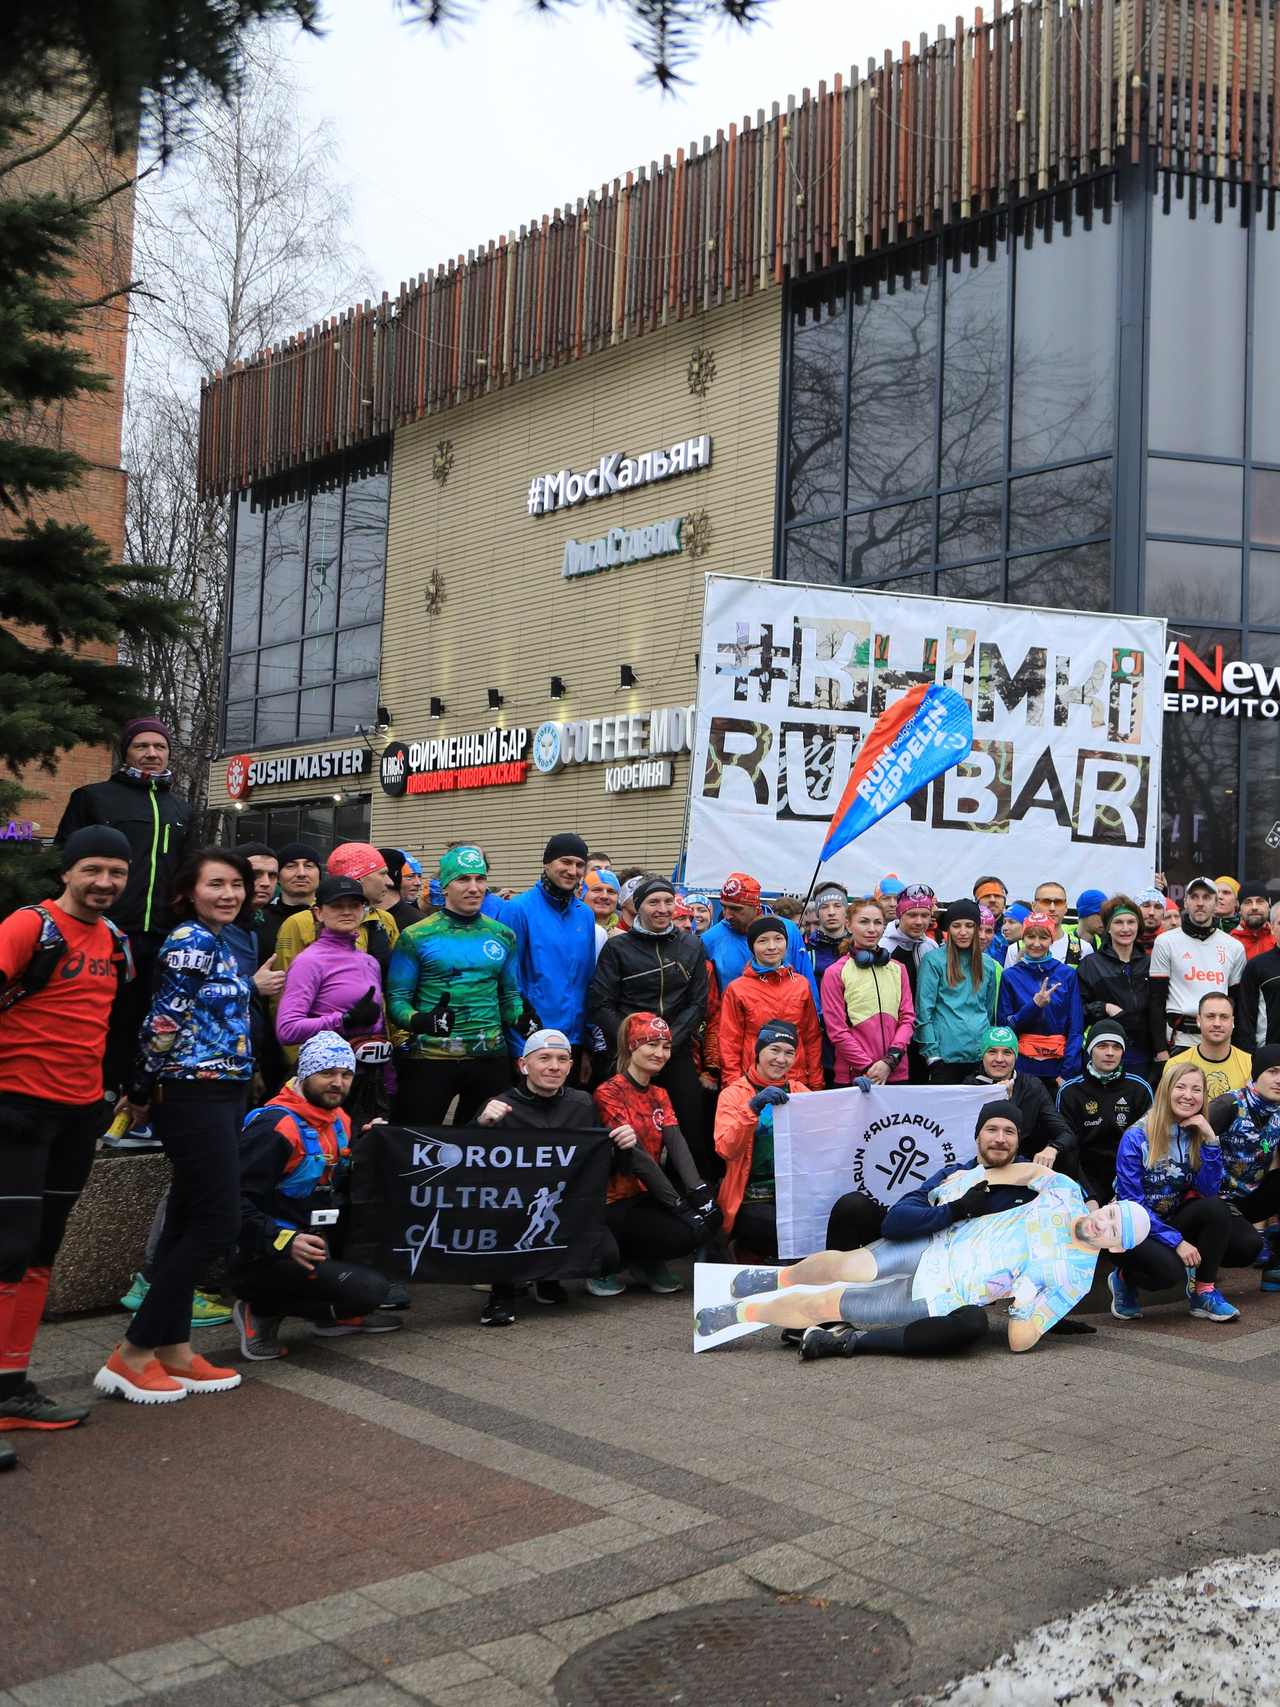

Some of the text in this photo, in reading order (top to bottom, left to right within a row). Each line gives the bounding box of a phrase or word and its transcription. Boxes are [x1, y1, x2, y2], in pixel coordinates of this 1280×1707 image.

[527, 435, 712, 515] #МосКальян
[408, 726, 527, 772] ФИРМЕННЫЙ БАР
[561, 712, 651, 764] COFFEE
[247, 750, 364, 787] SUSHI MASTER
[605, 759, 664, 792] КОФЕЙНЯ
[856, 744, 897, 801] RUN
[870, 699, 948, 816] ZEPPELIN
[406, 769, 455, 795] ПИВОВАРНЯ
[703, 717, 1151, 848] RUBAR
[1184, 966, 1225, 985] Jeep
[412, 1143, 577, 1168] KOROLEV
[410, 1185, 524, 1209] ULTRA
[405, 1218, 499, 1251] CLUB
